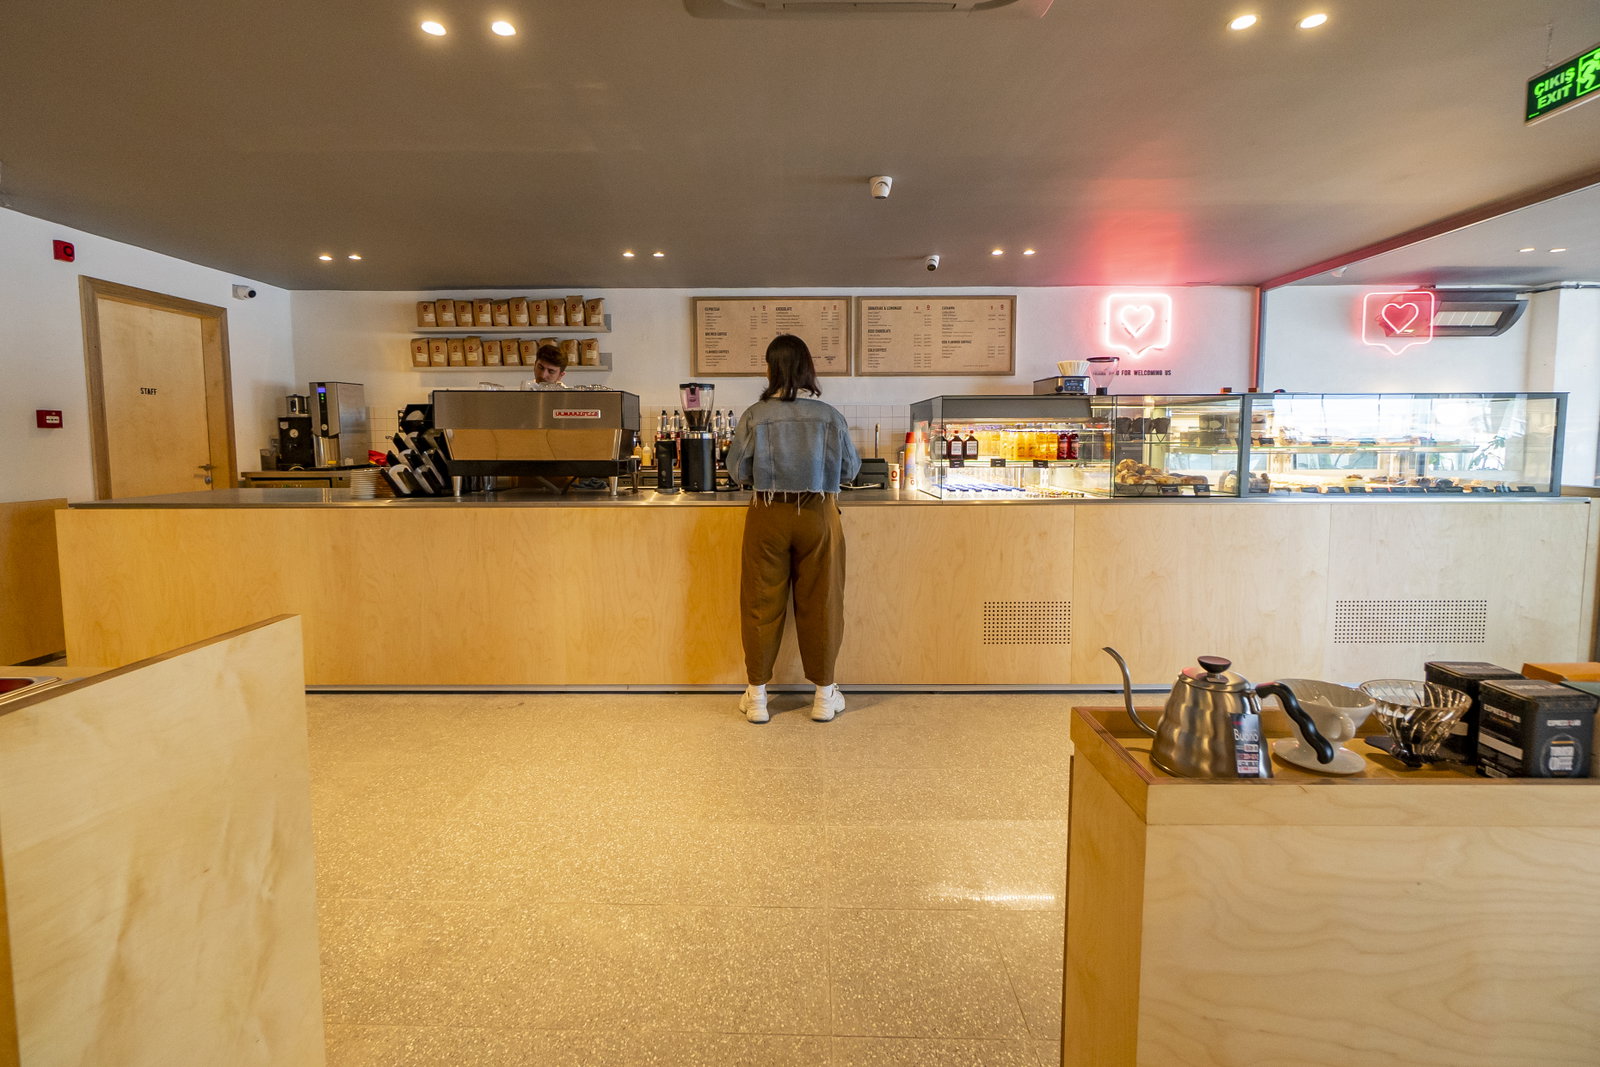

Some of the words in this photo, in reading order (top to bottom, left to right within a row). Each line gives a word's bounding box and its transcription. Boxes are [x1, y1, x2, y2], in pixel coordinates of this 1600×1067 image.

[1534, 67, 1576, 98] ÇIKIŞ
[1537, 83, 1573, 109] EXIT
[140, 387, 157, 395] STAFF
